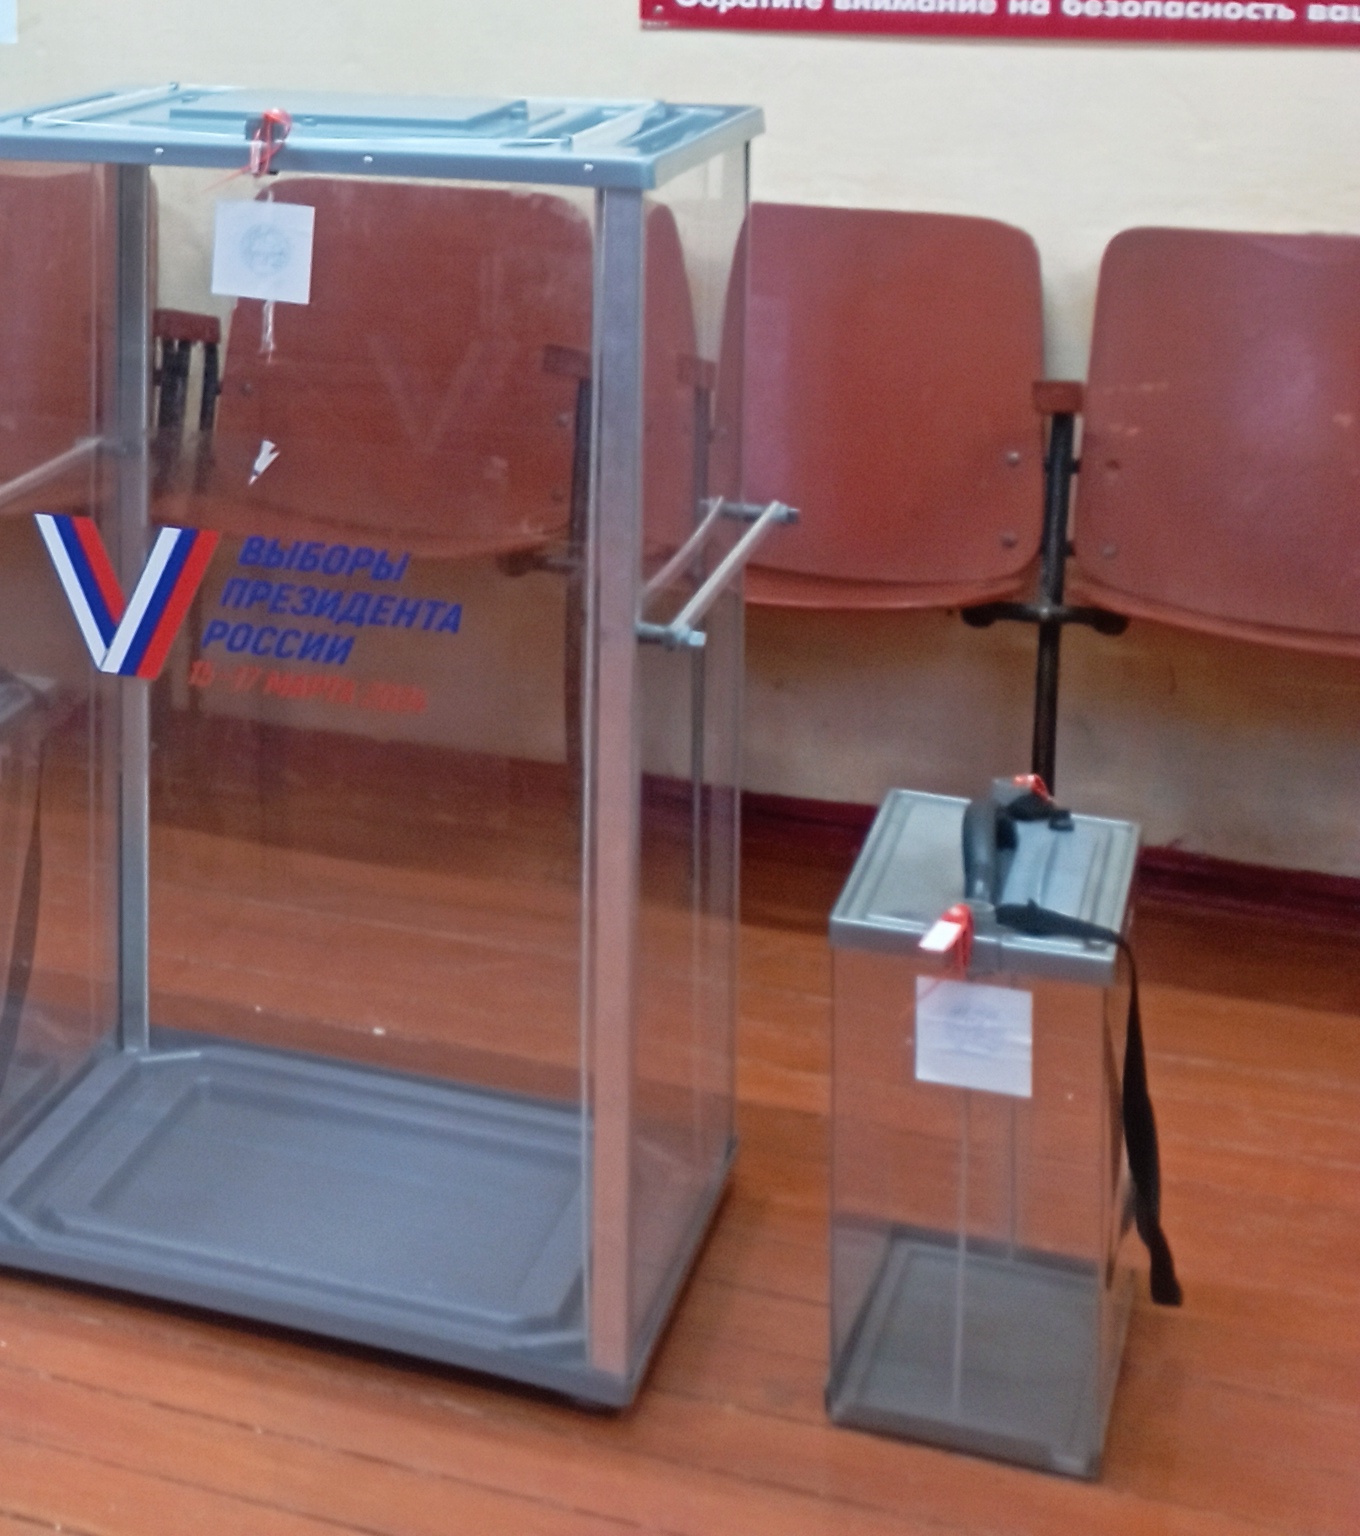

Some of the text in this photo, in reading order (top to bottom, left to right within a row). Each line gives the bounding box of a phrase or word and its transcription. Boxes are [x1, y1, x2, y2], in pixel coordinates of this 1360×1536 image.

[236, 534, 412, 583] ВЫБОРЫ
[220, 576, 464, 636] ПРЕЗИДЕНТА
[201, 618, 356, 668] РОССИИ
